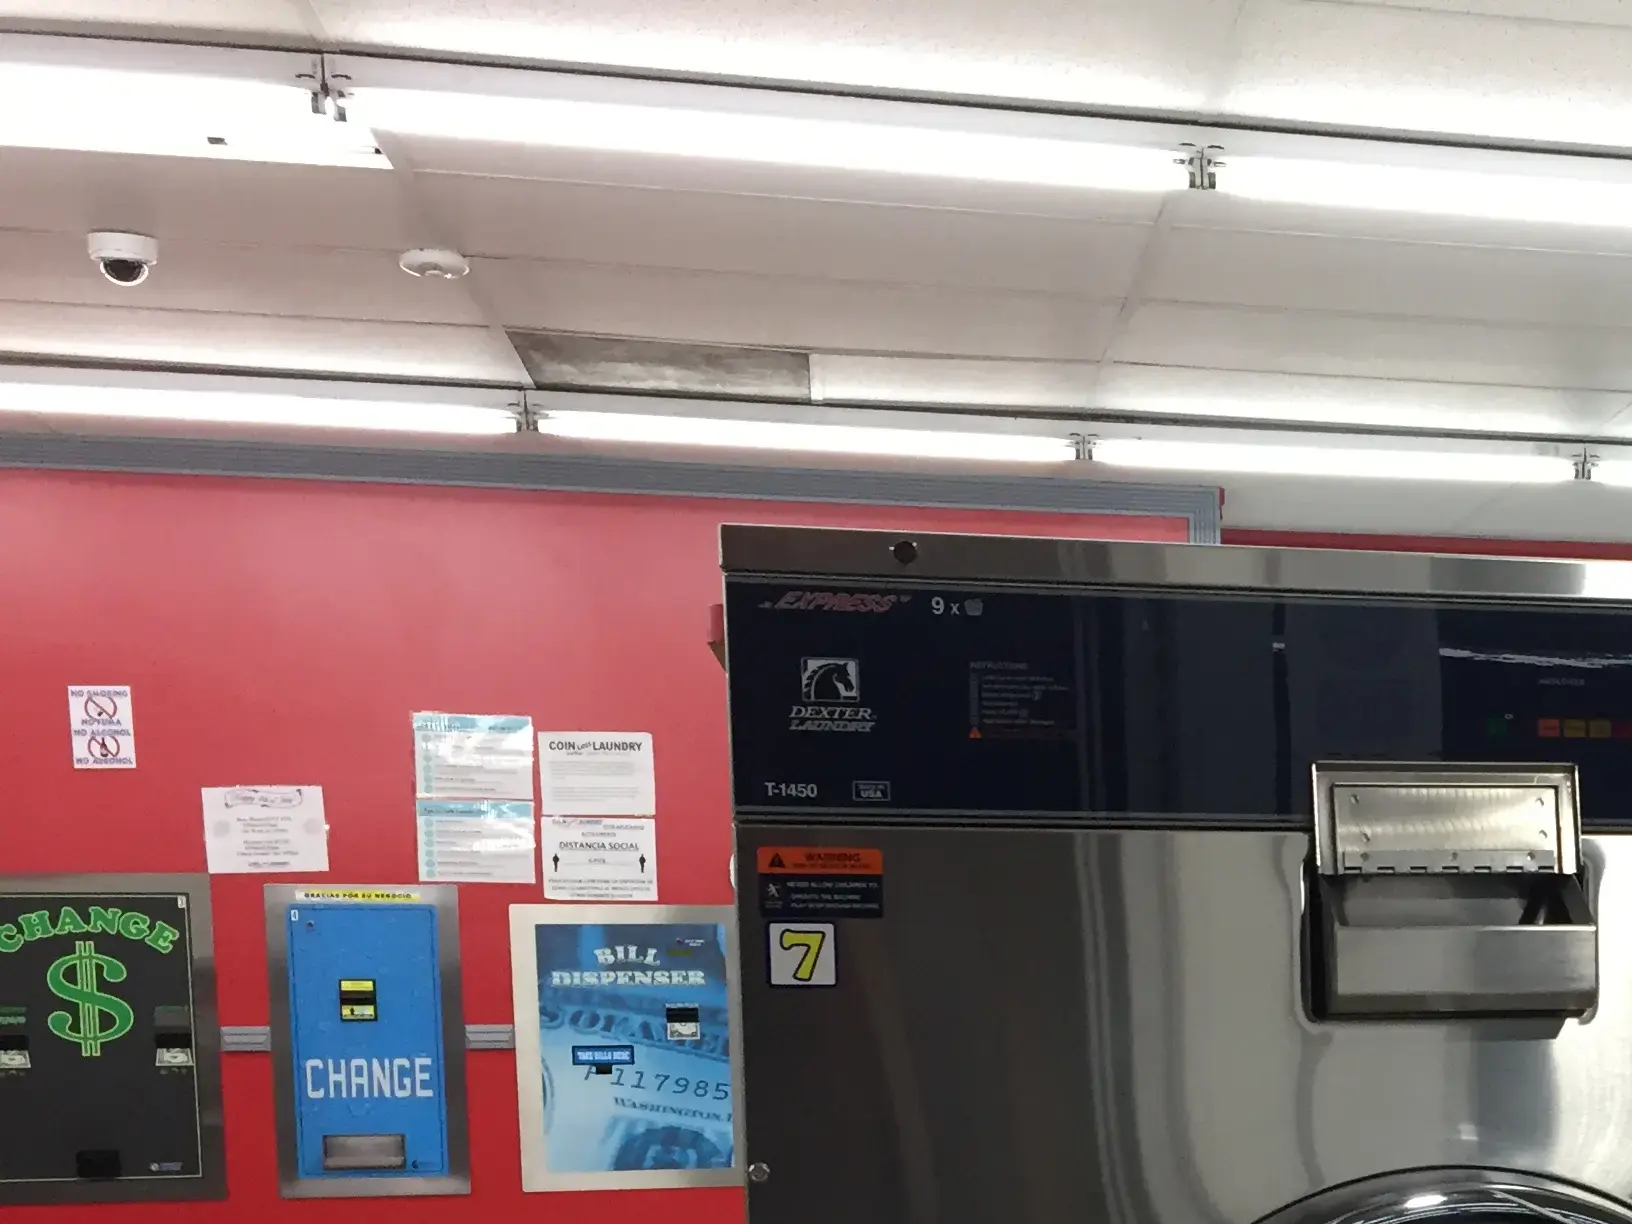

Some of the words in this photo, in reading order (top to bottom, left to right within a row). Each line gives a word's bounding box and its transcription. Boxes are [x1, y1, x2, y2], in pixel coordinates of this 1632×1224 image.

[775, 591, 898, 612] EXPRESS
[931, 597, 945, 615] 9
[789, 705, 872, 720] DEXTER
[789, 719, 876, 732] LAUNDRY
[549, 740, 576, 751] COIN
[592, 741, 643, 751] LAUNDRY
[764, 782, 818, 798] T-1450
[861, 789, 883, 798] USA
[559, 841, 606, 851] DISTANCIA
[608, 842, 640, 852] SOCIAL
[804, 852, 861, 862] WARNING
[0, 906, 180, 954] CHANGE
[593, 945, 661, 967] BILL
[779, 928, 826, 982] 7
[549, 970, 707, 987] DISPENSER
[305, 1057, 434, 1099] CHANGE
